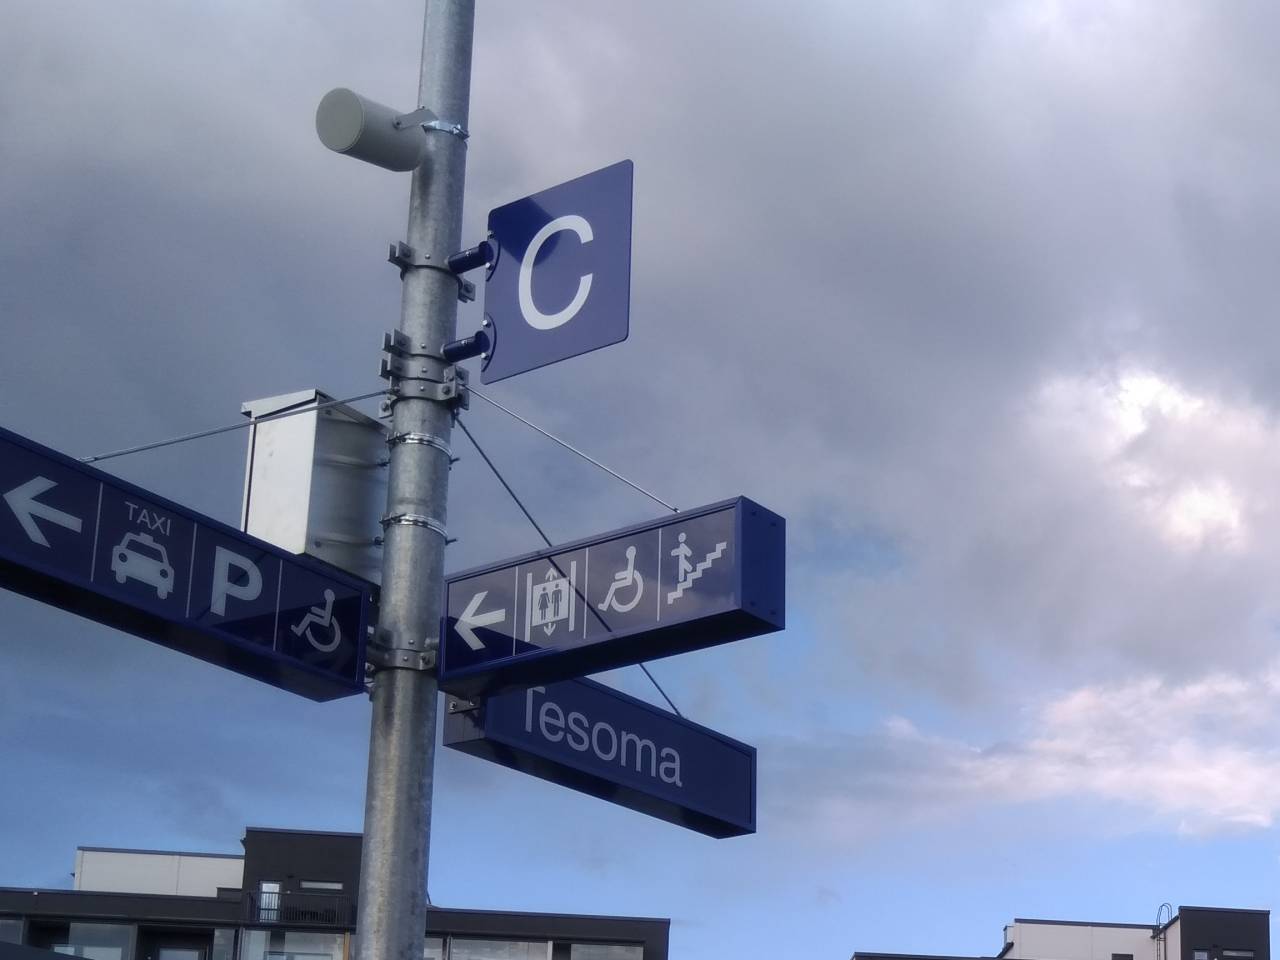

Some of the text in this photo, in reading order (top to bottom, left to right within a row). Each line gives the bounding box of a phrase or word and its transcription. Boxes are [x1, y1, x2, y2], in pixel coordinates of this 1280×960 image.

[518, 214, 593, 330] C
[124, 500, 171, 537] TAXI
[210, 545, 263, 617] P
[525, 685, 683, 788] Tesoma
